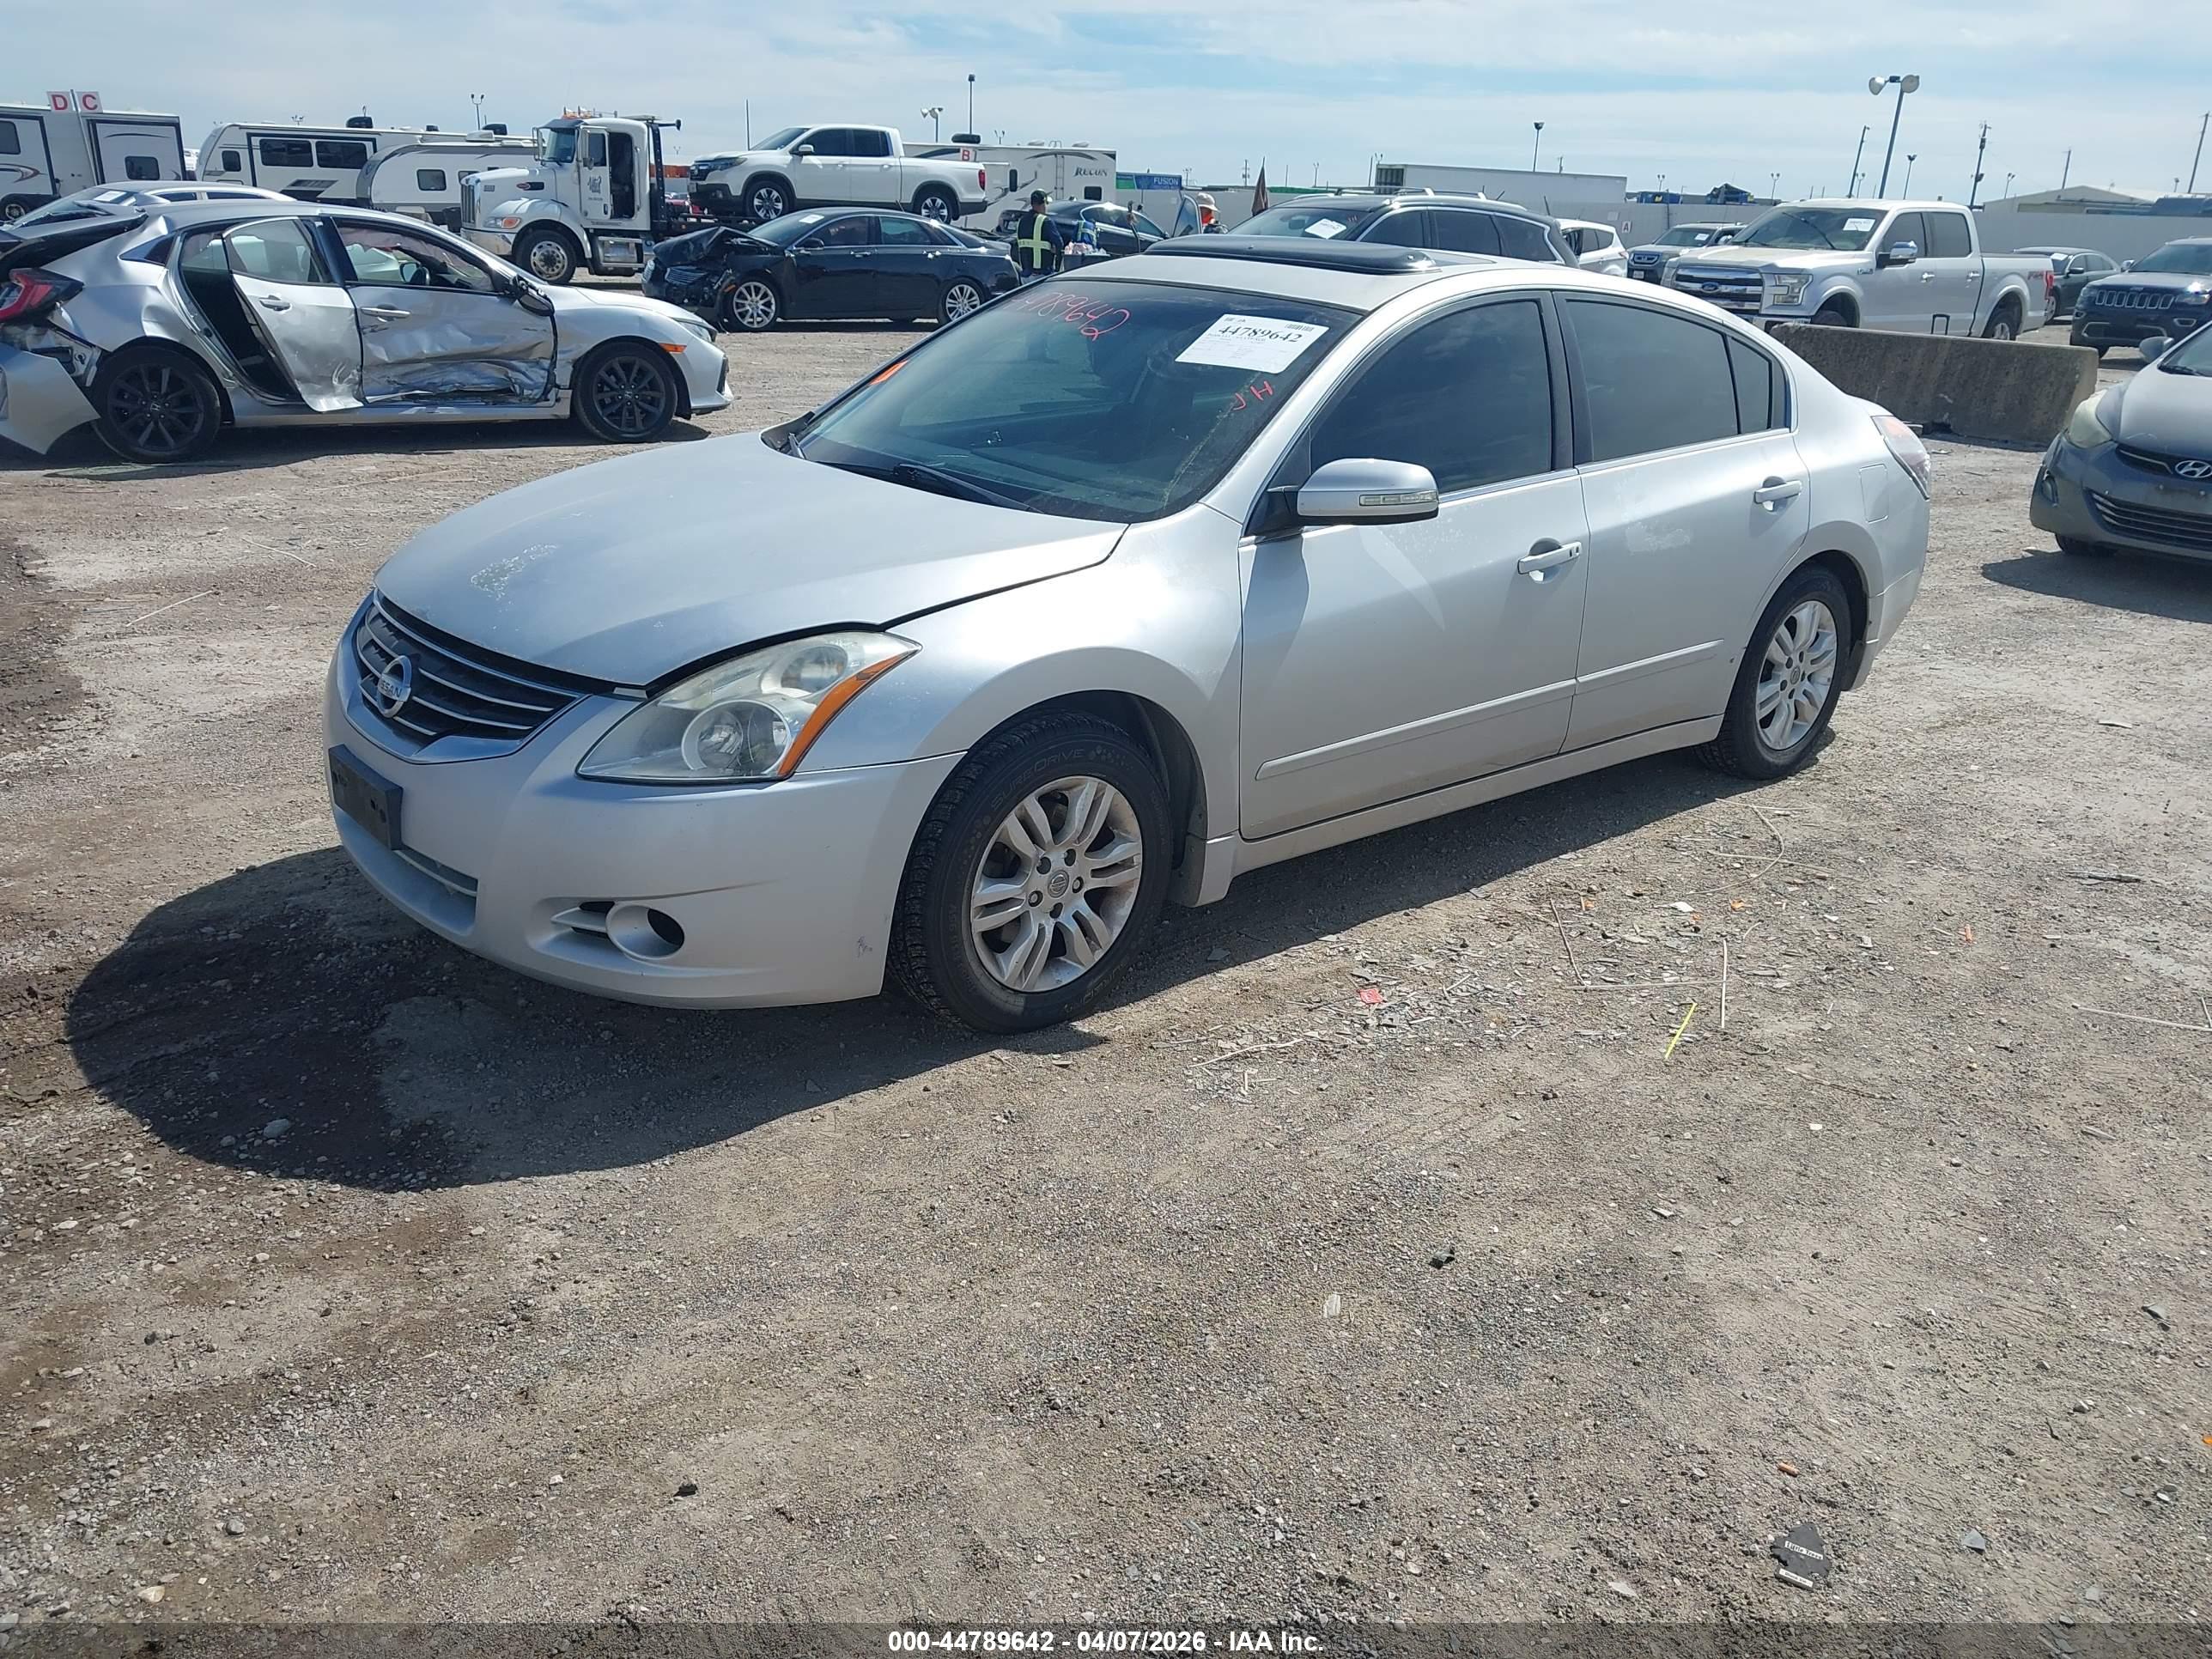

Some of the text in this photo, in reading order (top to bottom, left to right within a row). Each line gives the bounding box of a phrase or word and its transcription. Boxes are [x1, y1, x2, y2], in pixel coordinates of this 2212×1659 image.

[52, 94, 68, 111] D
[82, 94, 99, 111] C
[962, 149, 970, 161] B
[1153, 176, 1180, 186] FUSION
[1623, 222, 1629, 232] A
[1218, 325, 1304, 343] 44789642
